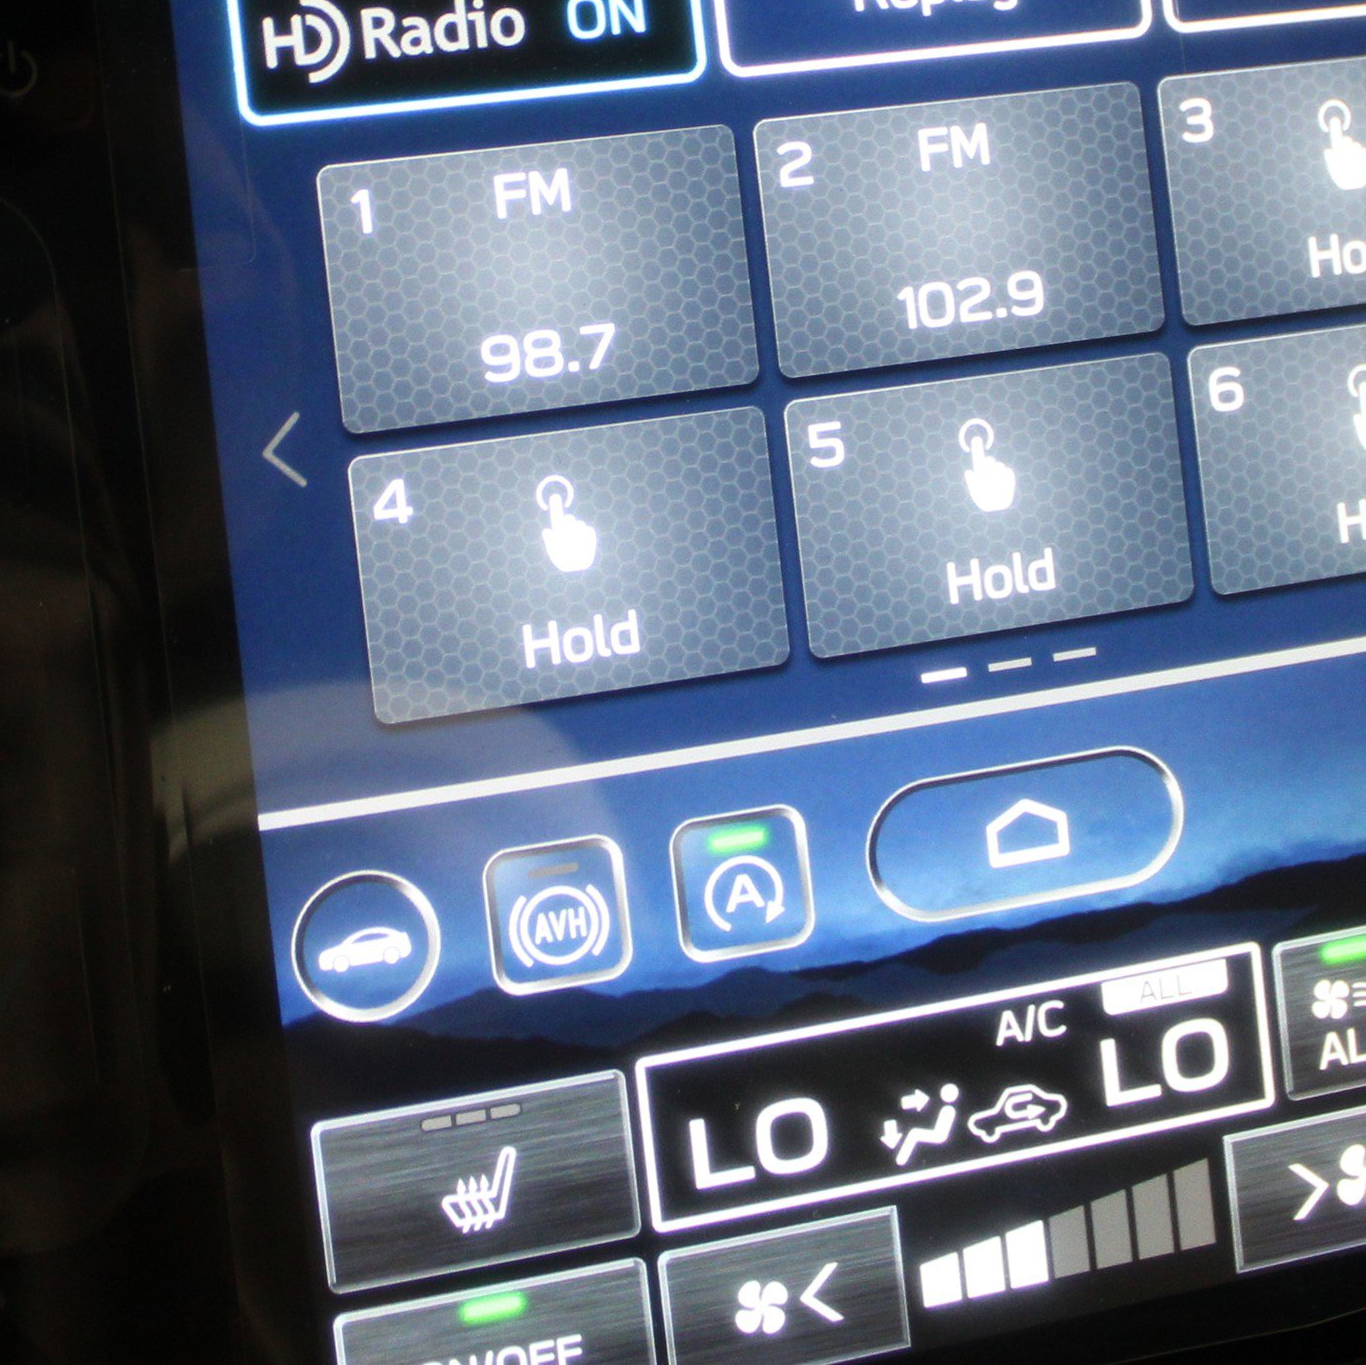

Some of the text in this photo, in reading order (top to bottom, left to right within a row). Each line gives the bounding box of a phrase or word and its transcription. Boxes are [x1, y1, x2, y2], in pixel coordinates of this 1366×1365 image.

[1178, 97, 1215, 144] 3
[776, 140, 815, 188] 2
[917, 122, 991, 173] FM
[350, 188, 374, 235] 1
[493, 167, 572, 220] FM
[896, 270, 1045, 330] 102.9
[479, 322, 616, 383] 98.7
[1207, 366, 1245, 413] 6
[807, 420, 846, 469] 5
[372, 478, 414, 524] 4
[945, 547, 1057, 605] Hold
[521, 608, 641, 669] Hold
[534, 906, 589, 946] AVH
[995, 999, 1067, 1047] A/C
[1100, 1018, 1230, 1108] LO
[688, 1096, 829, 1191] LO
